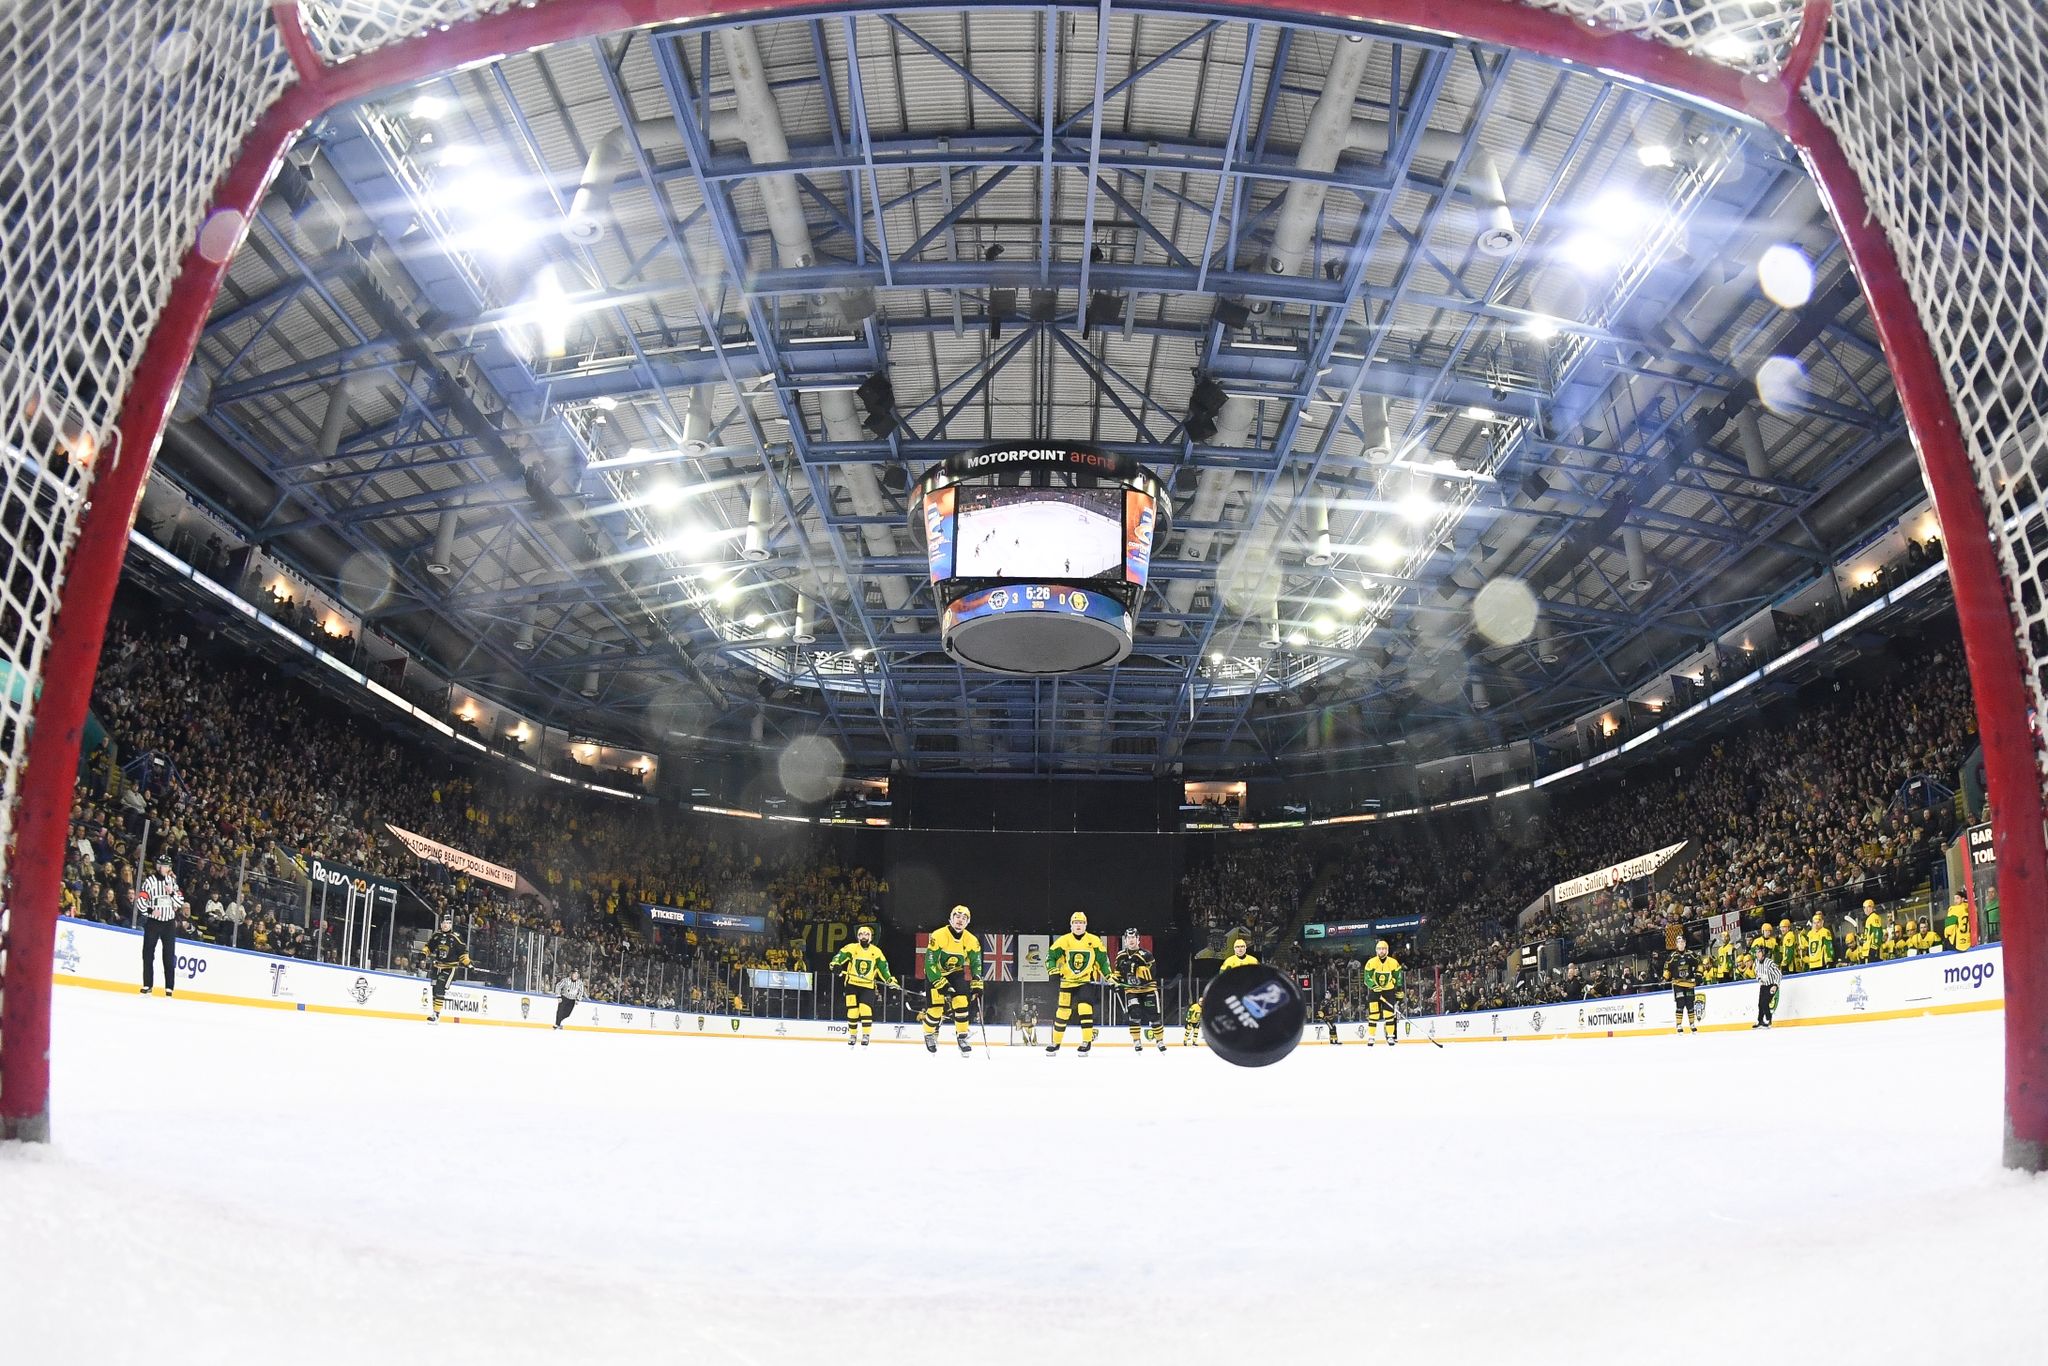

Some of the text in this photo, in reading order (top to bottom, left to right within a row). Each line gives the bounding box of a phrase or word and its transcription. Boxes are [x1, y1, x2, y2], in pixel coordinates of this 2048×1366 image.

[967, 449, 1116, 471] MOTORPOINT arena
[1012, 593, 1018, 604] 3
[1026, 587, 1050, 600] 5:26
[1059, 593, 1065, 604] 0
[1971, 828, 1993, 846] BAR
[1973, 847, 1996, 865] TOIL
[444, 851, 466, 866] BEAUTY
[467, 859, 485, 874] TOOLS
[485, 866, 501, 880] SINCE
[501, 872, 514, 884] 1980
[1558, 881, 1583, 900] Estrella
[1584, 873, 1609, 891] Galicia
[1622, 859, 1653, 880] Estrella
[1944, 962, 1994, 988] mogo
[444, 999, 479, 1012] TTINGHAM
[1225, 994, 1259, 1028] IIHF
[620, 1012, 633, 1024] mogo
[1456, 1020, 1469, 1032] mogo
[1588, 1011, 1634, 1026] NOTTINGHAM
